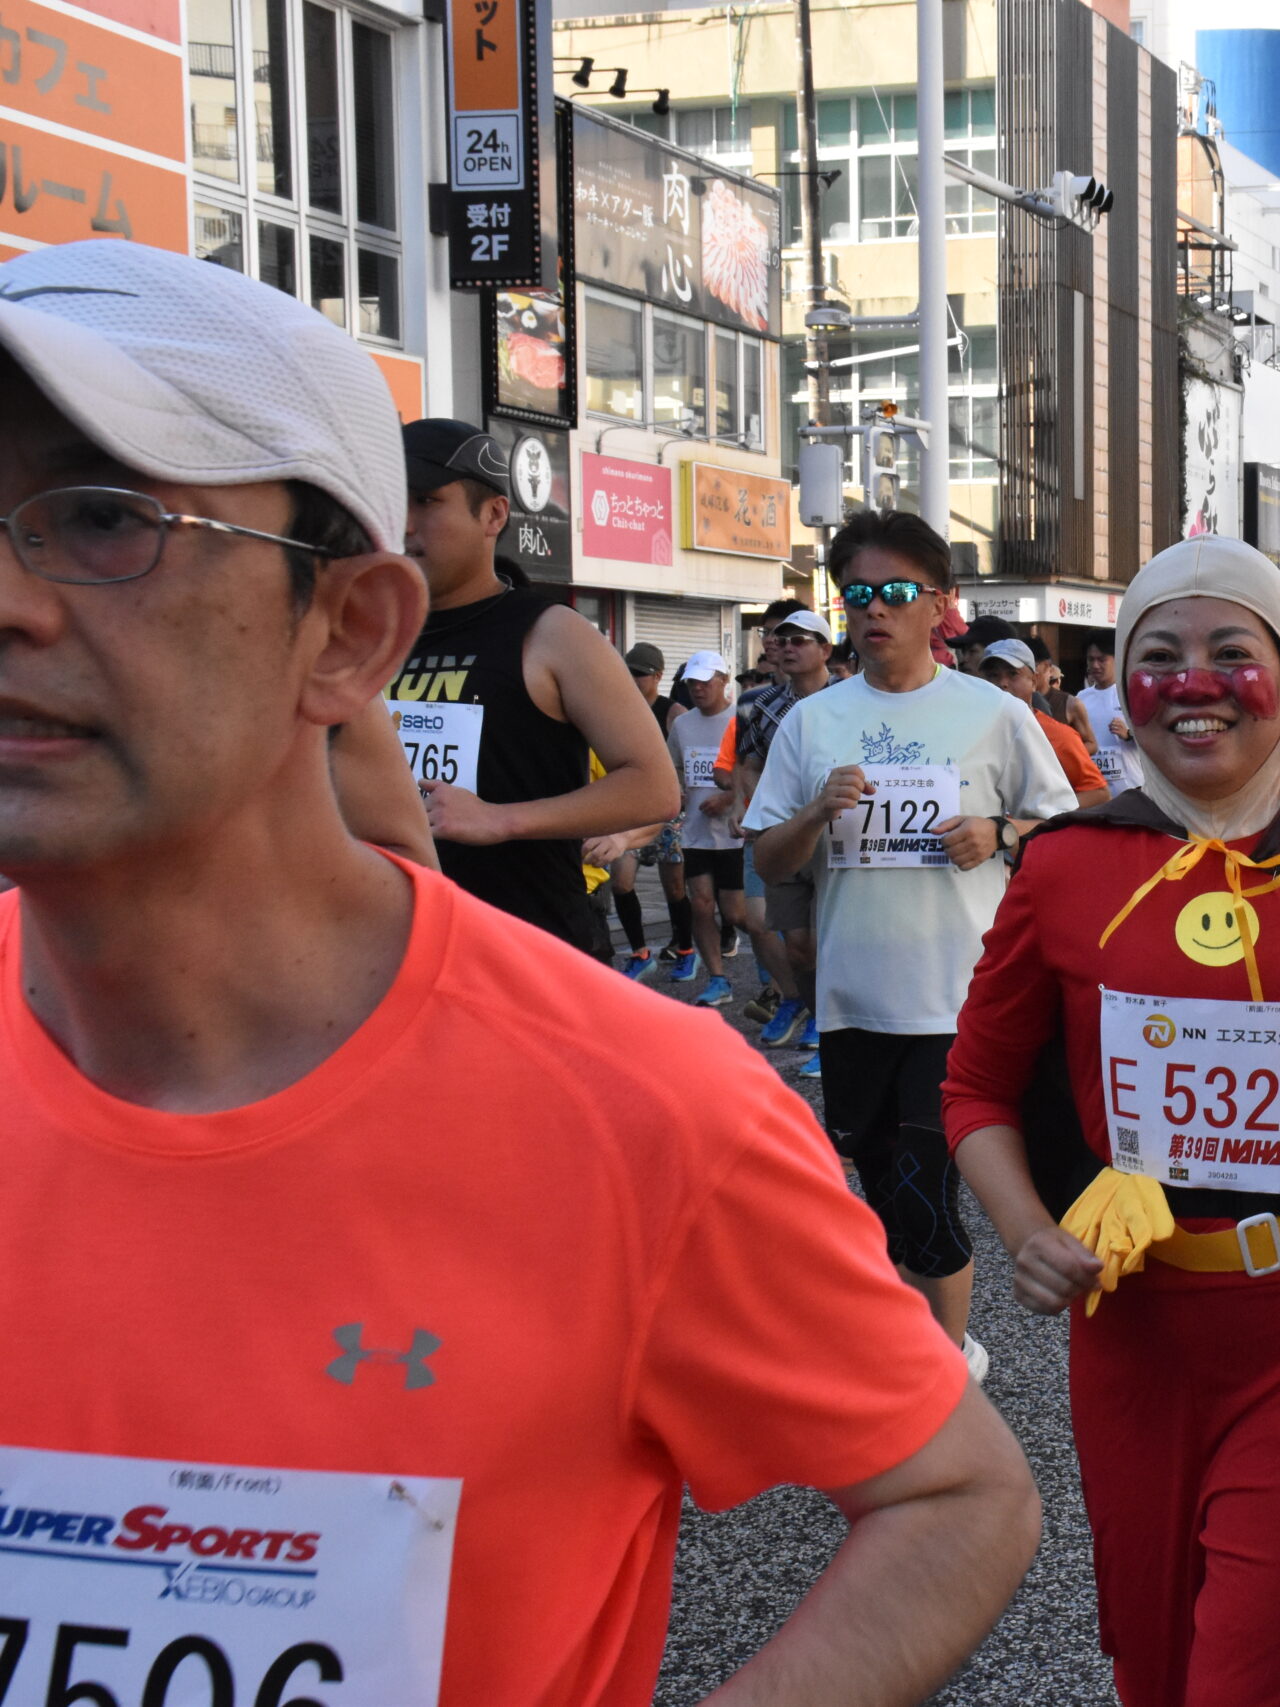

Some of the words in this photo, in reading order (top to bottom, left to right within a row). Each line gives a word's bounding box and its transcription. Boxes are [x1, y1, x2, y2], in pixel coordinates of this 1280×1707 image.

[466, 129, 509, 155] 24h
[463, 156, 512, 173] OPEN
[466, 203, 511, 229] 受付
[470, 235, 509, 262] 2F
[402, 714, 444, 729] sato
[404, 742, 459, 784] 765
[1092, 757, 1114, 769] 941
[885, 779, 935, 788] エヌエヌ生命
[857, 799, 940, 834] 7122
[1183, 1028, 1206, 1040] NN
[1110, 1056, 1140, 1121] E
[0, 1503, 115, 1546] UPER
